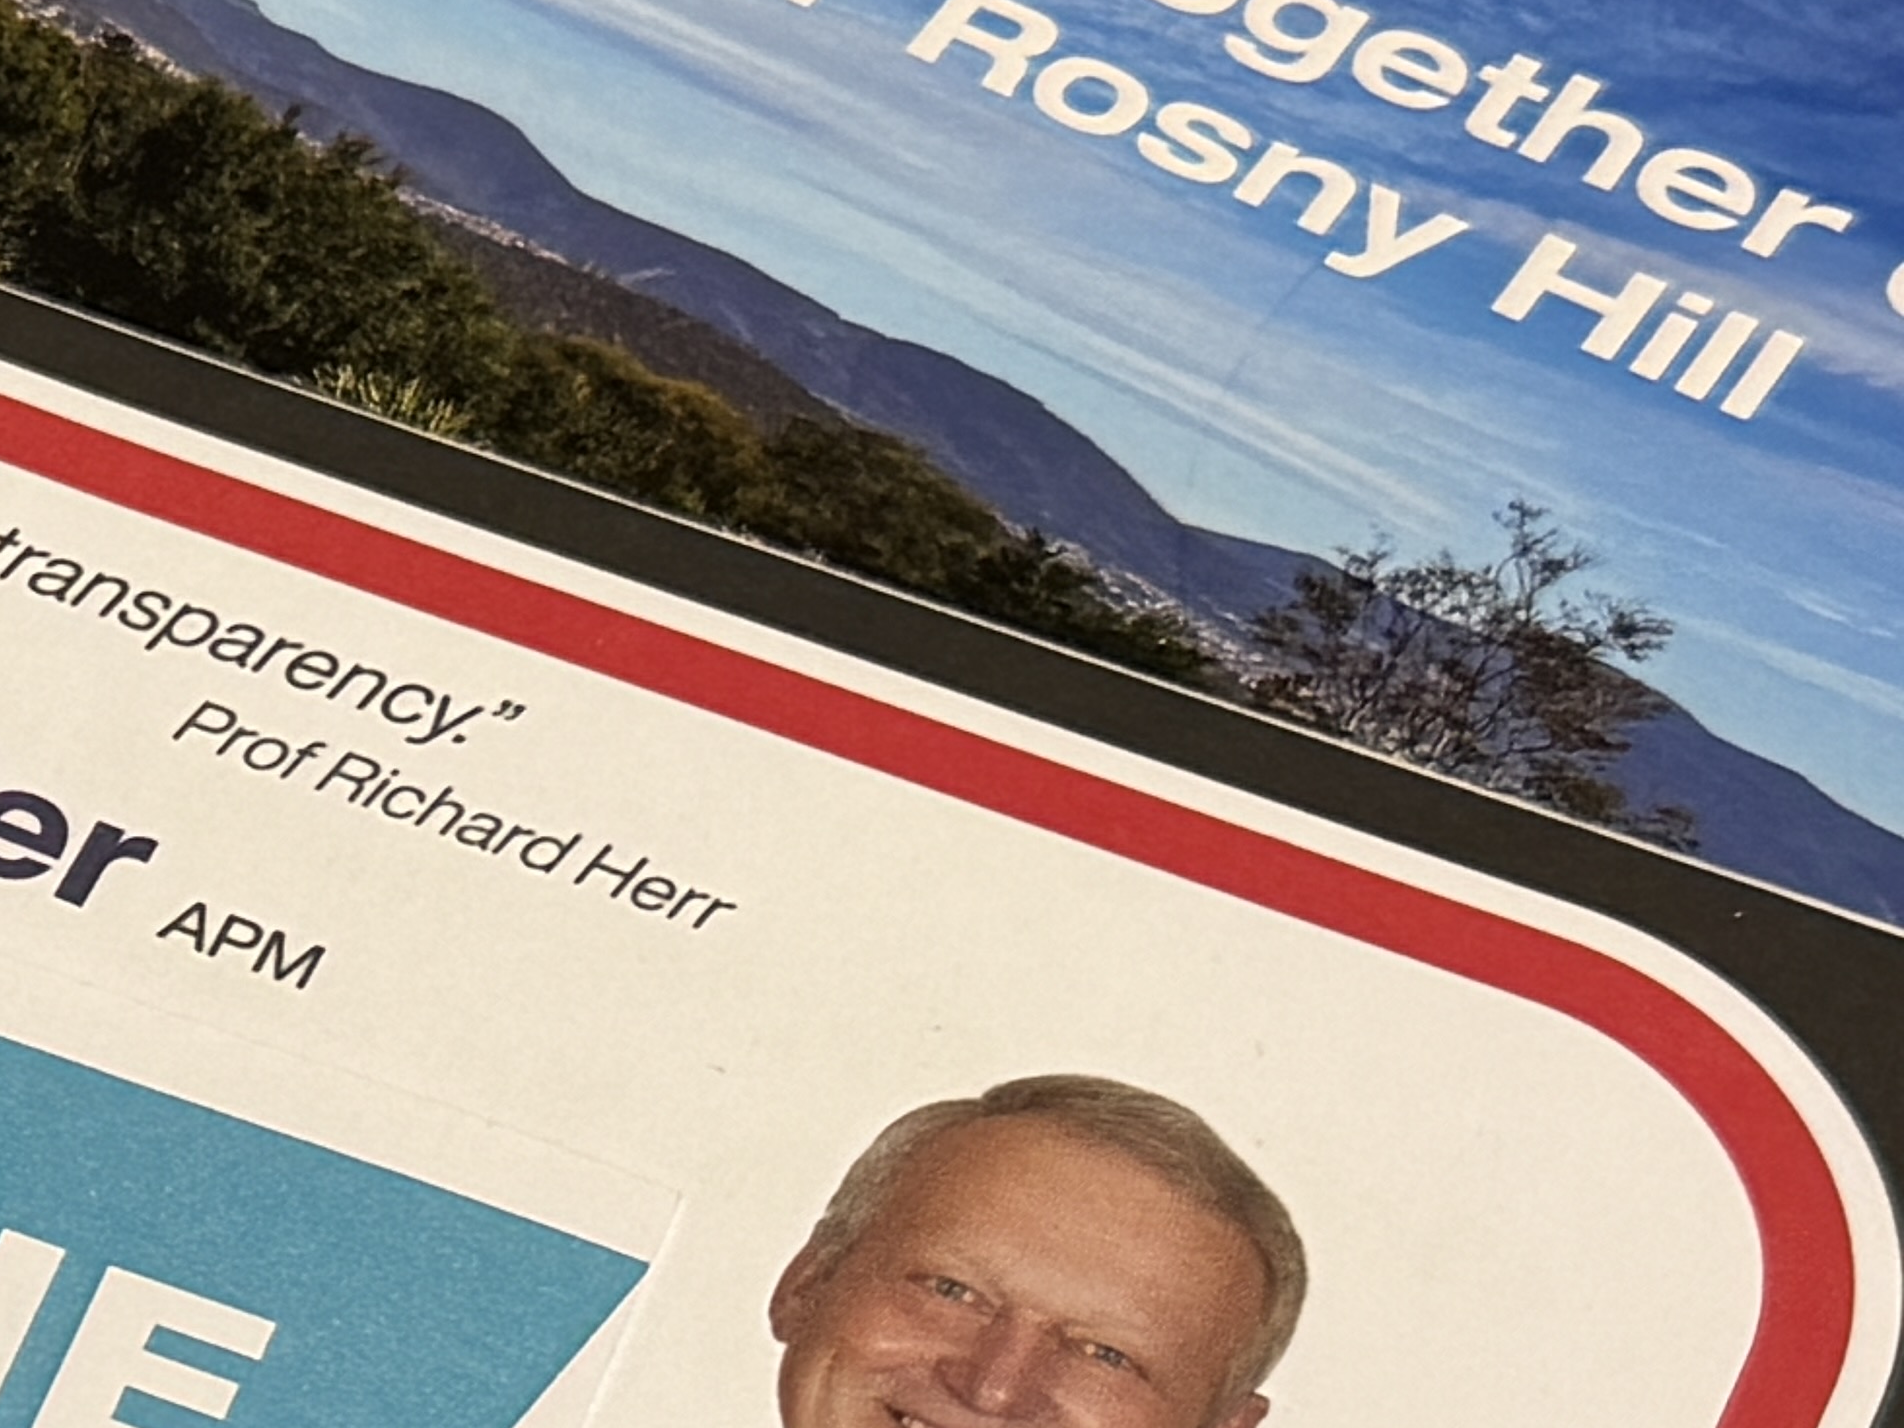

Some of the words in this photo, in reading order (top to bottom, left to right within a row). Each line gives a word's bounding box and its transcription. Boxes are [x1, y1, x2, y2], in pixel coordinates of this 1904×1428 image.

[1491, 233, 1805, 421] Hill
[172, 699, 327, 779] Prof
[314, 751, 583, 877] Richard
[574, 843, 739, 934] Herr
[155, 899, 328, 991] APM
